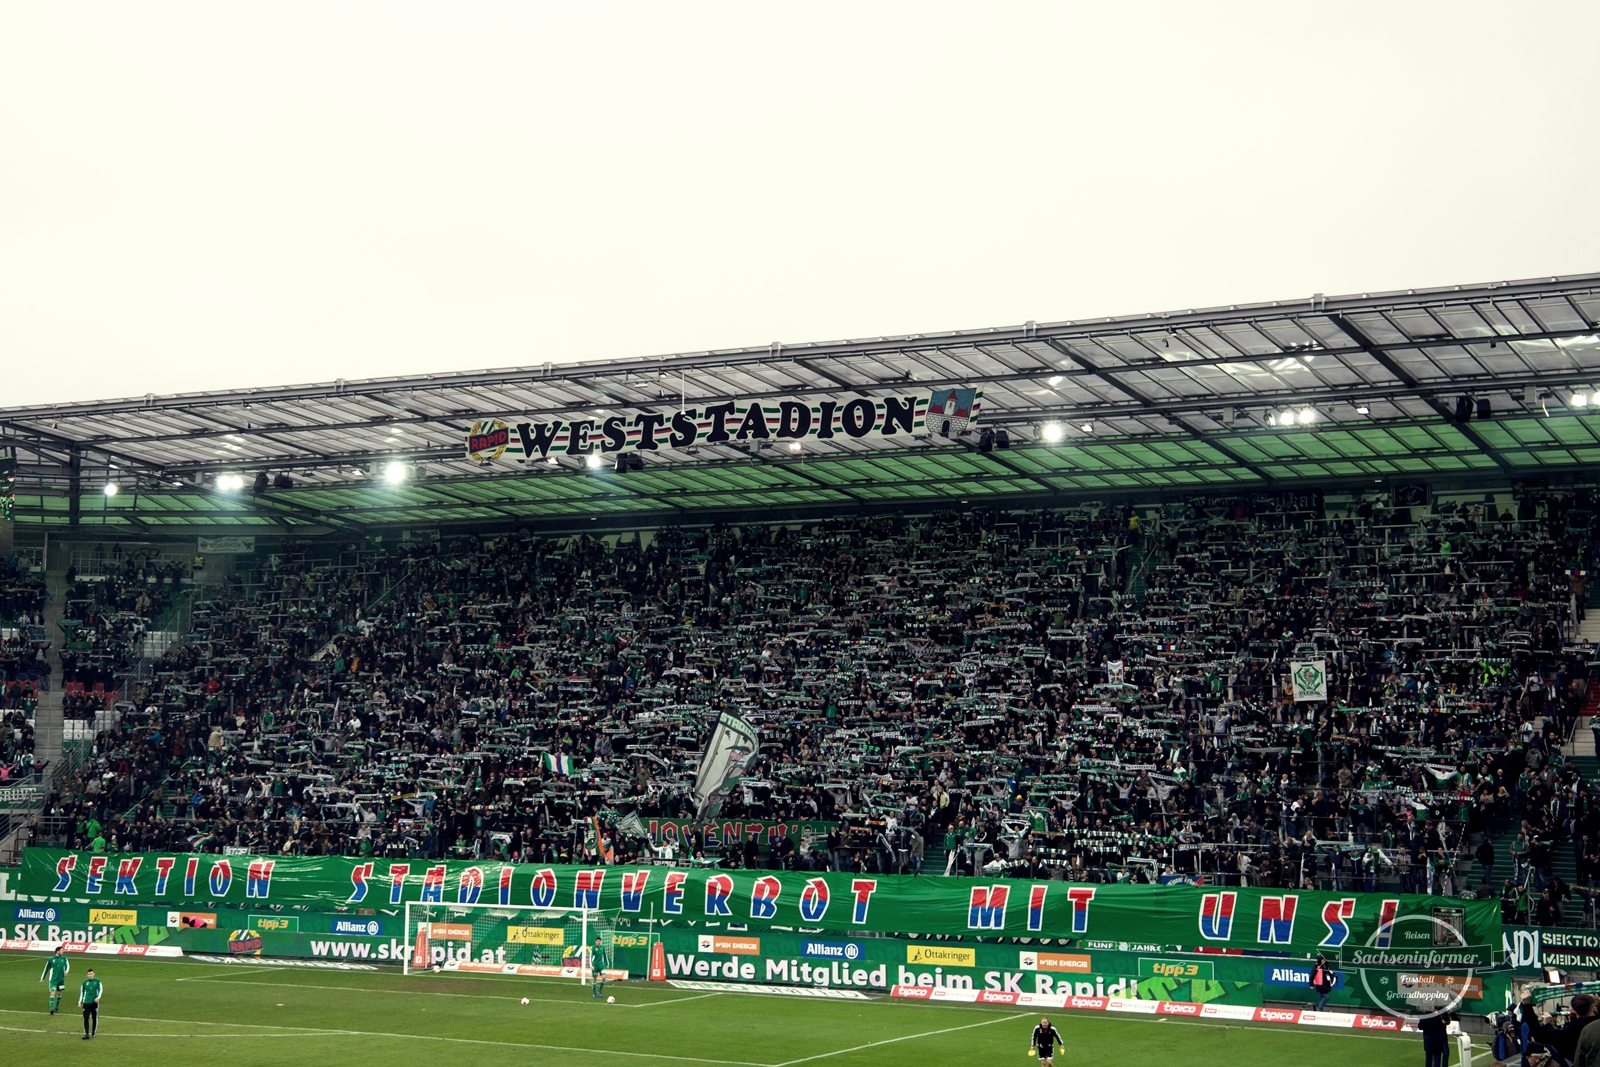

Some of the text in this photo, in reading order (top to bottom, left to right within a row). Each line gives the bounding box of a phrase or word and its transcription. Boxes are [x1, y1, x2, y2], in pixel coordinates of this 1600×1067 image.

[517, 397, 917, 457] WESTSTADION
[470, 429, 509, 451] RAPID
[52, 855, 275, 898] SEKTION
[345, 862, 877, 925] STADIONVERBOT
[967, 885, 1096, 933] MIT
[18, 909, 44, 919] Allianz
[101, 911, 133, 922] Ottakringer
[257, 918, 288, 930] tipp3
[336, 921, 366, 932] Allianz
[14, 924, 41, 942] SK
[48, 925, 115, 944] Rapid!
[522, 928, 560, 940] Ottakringer
[1542, 933, 1600, 947] SEKTIO
[230, 939, 262, 952] RAPID
[612, 935, 648, 947] tipp3
[310, 938, 506, 965] www.skrpid.at
[806, 943, 843, 956] Allianz
[924, 949, 971, 962] Ottakringer
[1059, 960, 1088, 968] ENERGIE
[1543, 953, 1600, 967] MEIDLIN
[667, 953, 755, 979] Werde
[766, 958, 887, 987] Mitglied
[899, 965, 973, 990] beim
[984, 971, 1024, 994] SK
[1035, 974, 1138, 999] Rapid!
[1152, 962, 1198, 978] tipp3
[1271, 968, 1309, 983] Allian
[898, 986, 927, 998] tipico
[983, 990, 1013, 1003] tipico
[1071, 996, 1102, 1009] tipico
[1163, 1002, 1196, 1014] tipico
[1259, 1008, 1294, 1023] tipico
[1361, 1015, 1396, 1029] tipico
